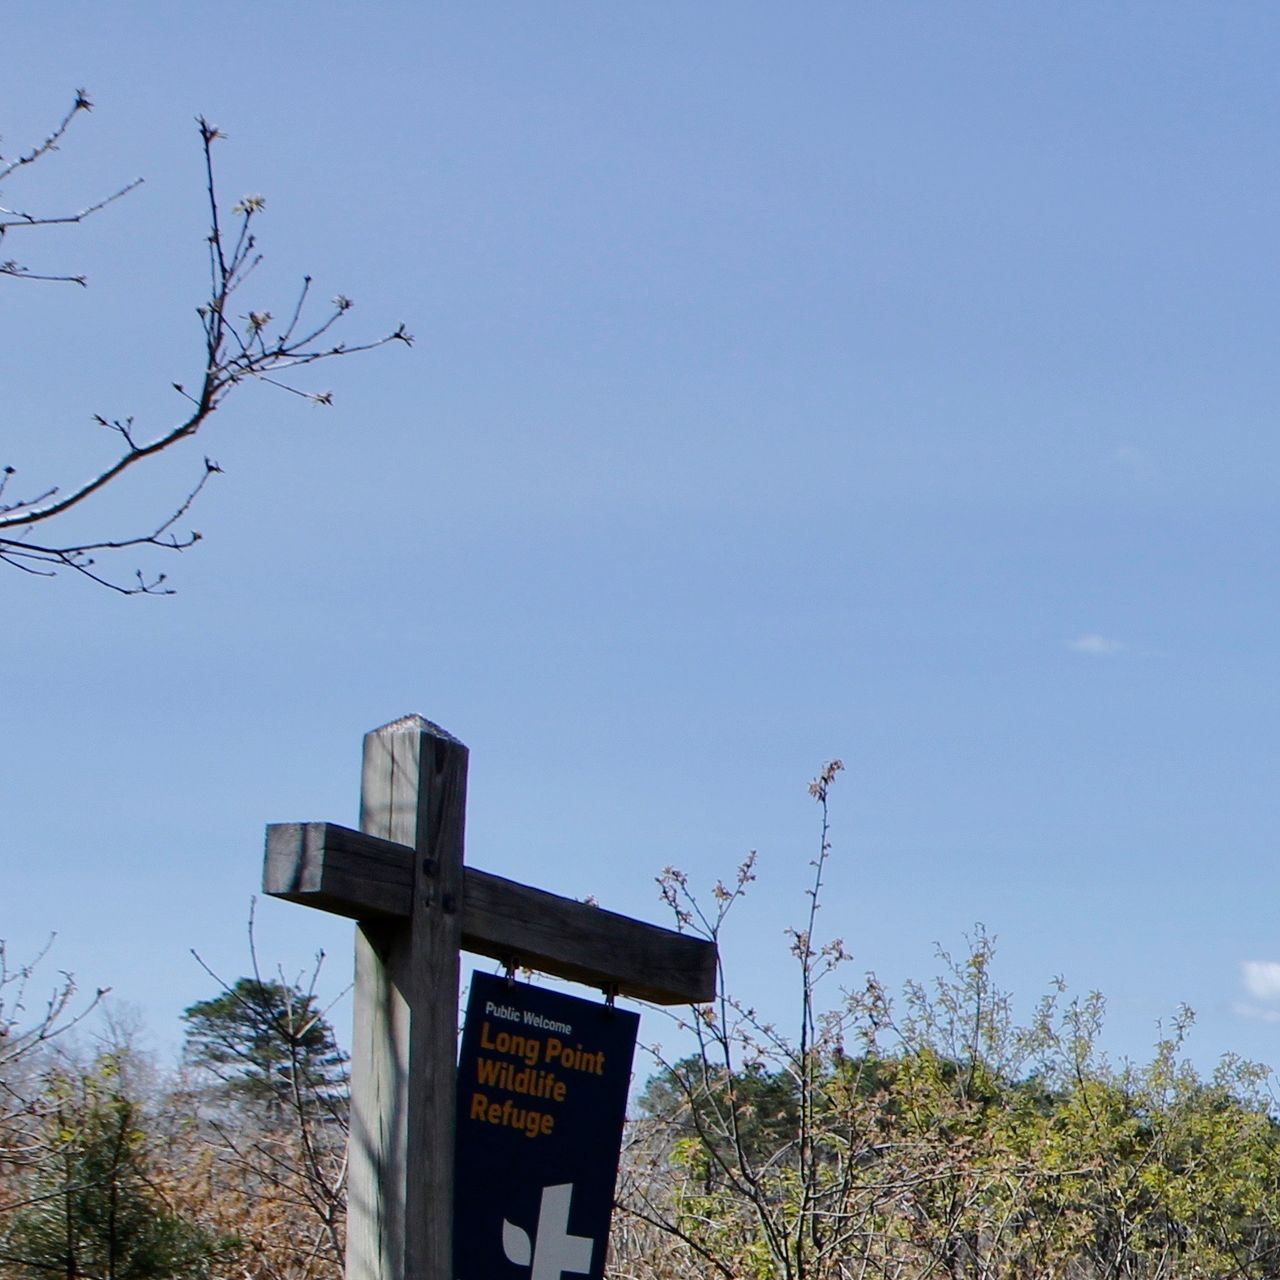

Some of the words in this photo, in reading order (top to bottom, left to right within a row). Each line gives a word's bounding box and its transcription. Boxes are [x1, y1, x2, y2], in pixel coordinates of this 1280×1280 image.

[485, 1001, 520, 1022] Public
[523, 1010, 572, 1035] Welcome
[480, 1022, 540, 1065] Long
[545, 1037, 606, 1075] Point
[477, 1057, 567, 1101] Wildlife
[470, 1092, 555, 1138] Refuge
